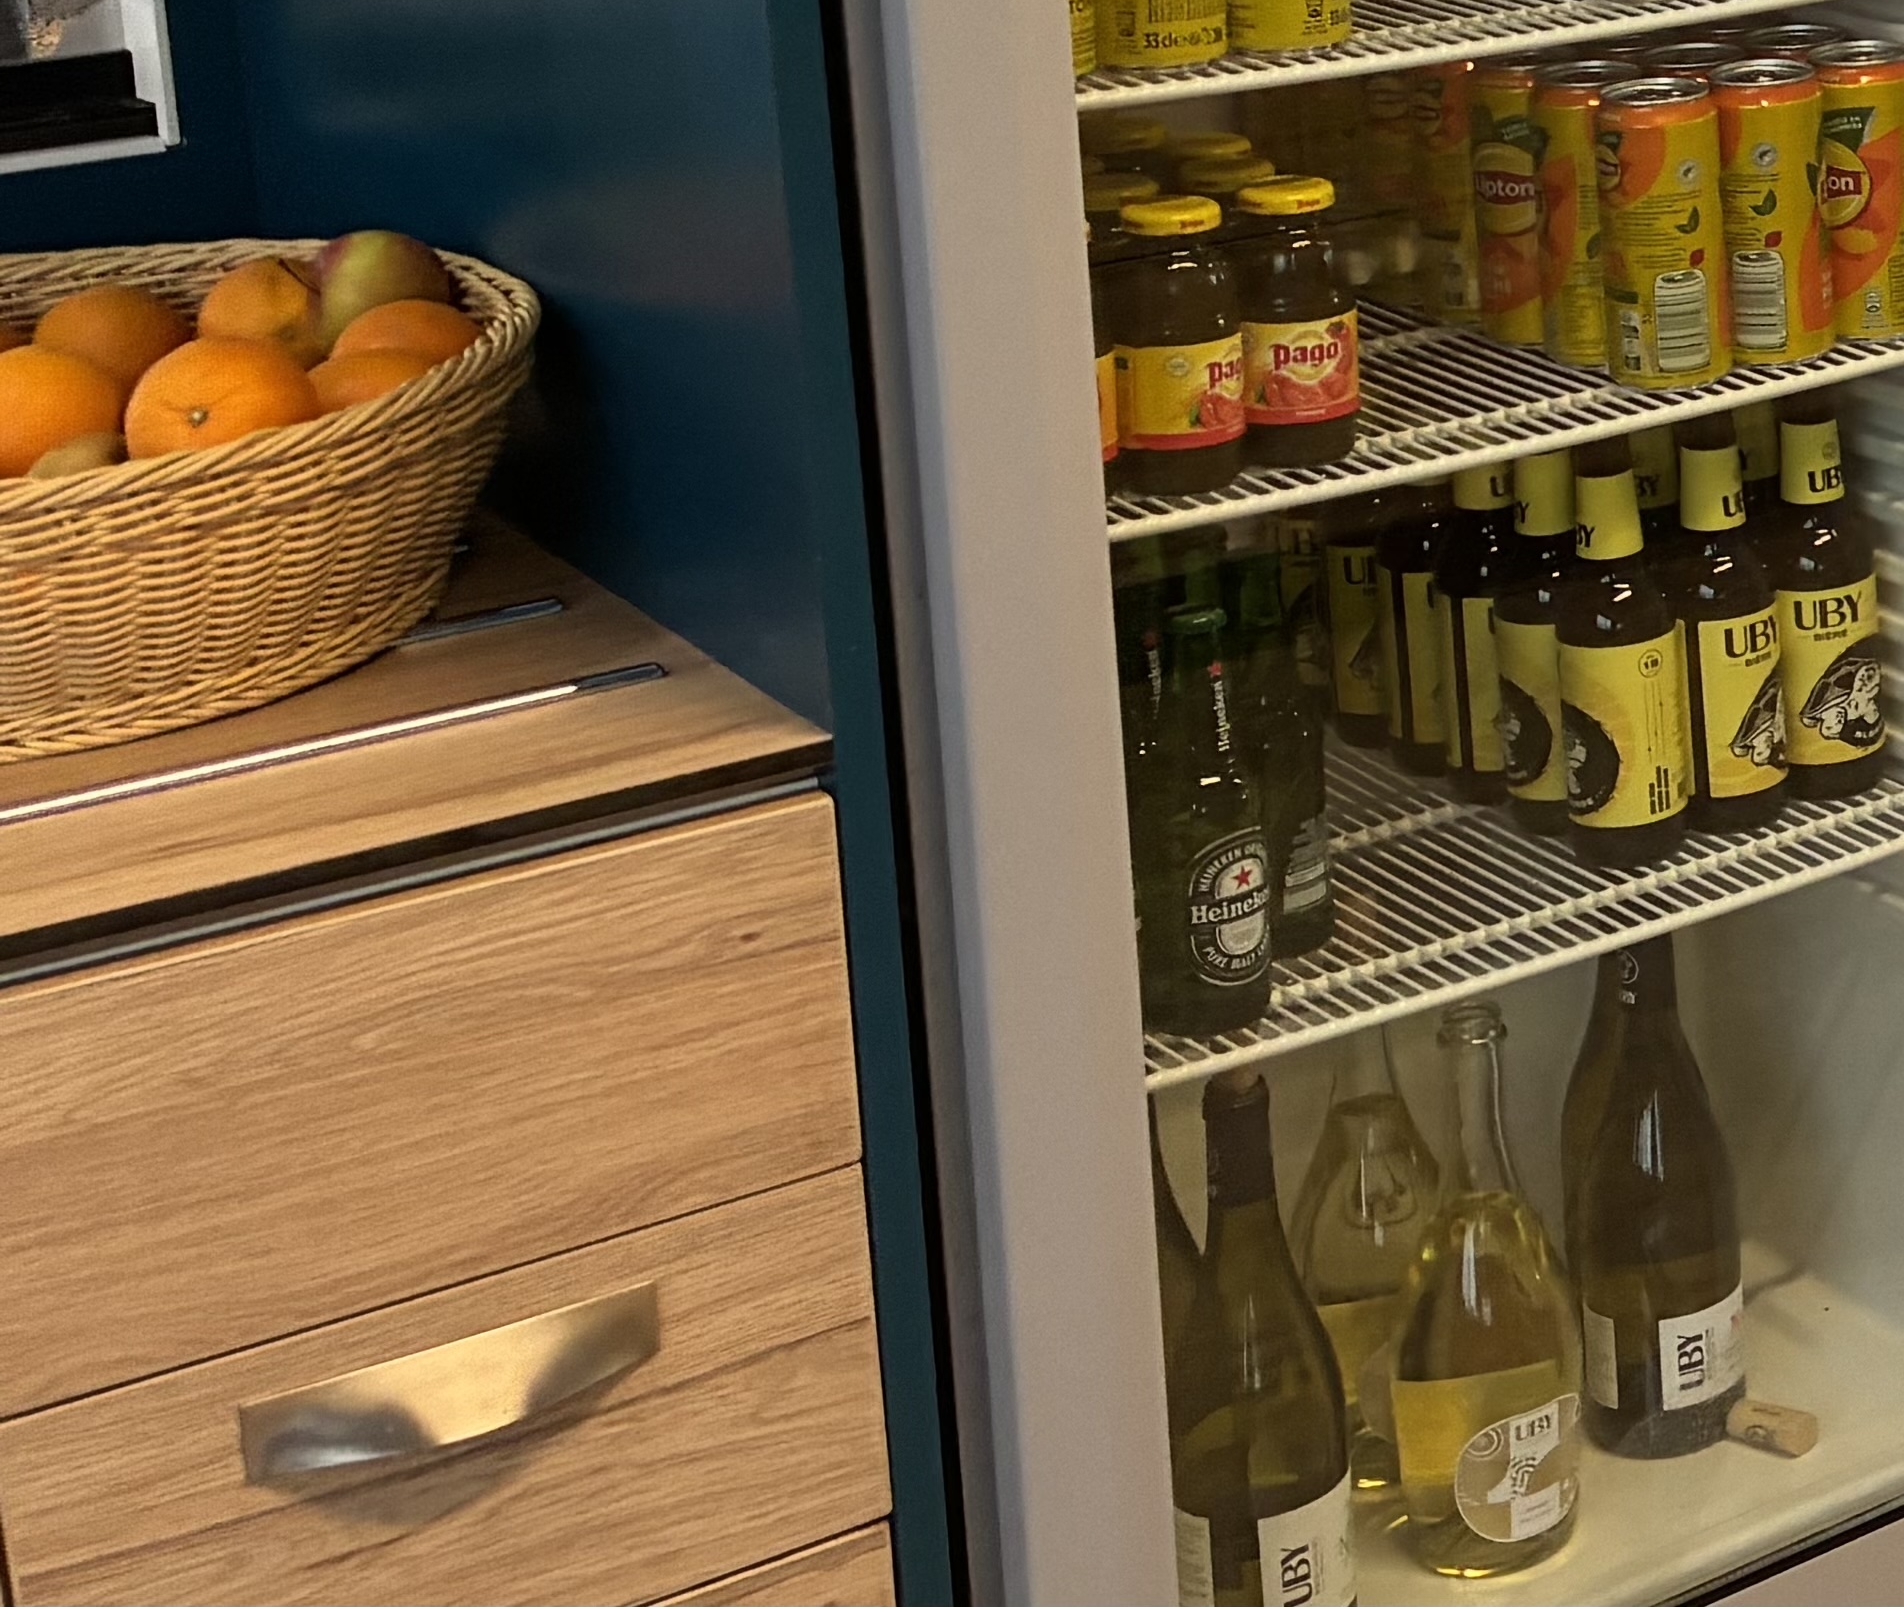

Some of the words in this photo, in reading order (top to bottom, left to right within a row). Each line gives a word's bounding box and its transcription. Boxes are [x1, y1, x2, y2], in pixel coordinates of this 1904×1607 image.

[1273, 341, 1340, 372] pago
[1807, 465, 1842, 493] UB
[1793, 591, 1862, 632] UBY
[1679, 1332, 1706, 1392] UBY
[1514, 1414, 1552, 1442] UBY
